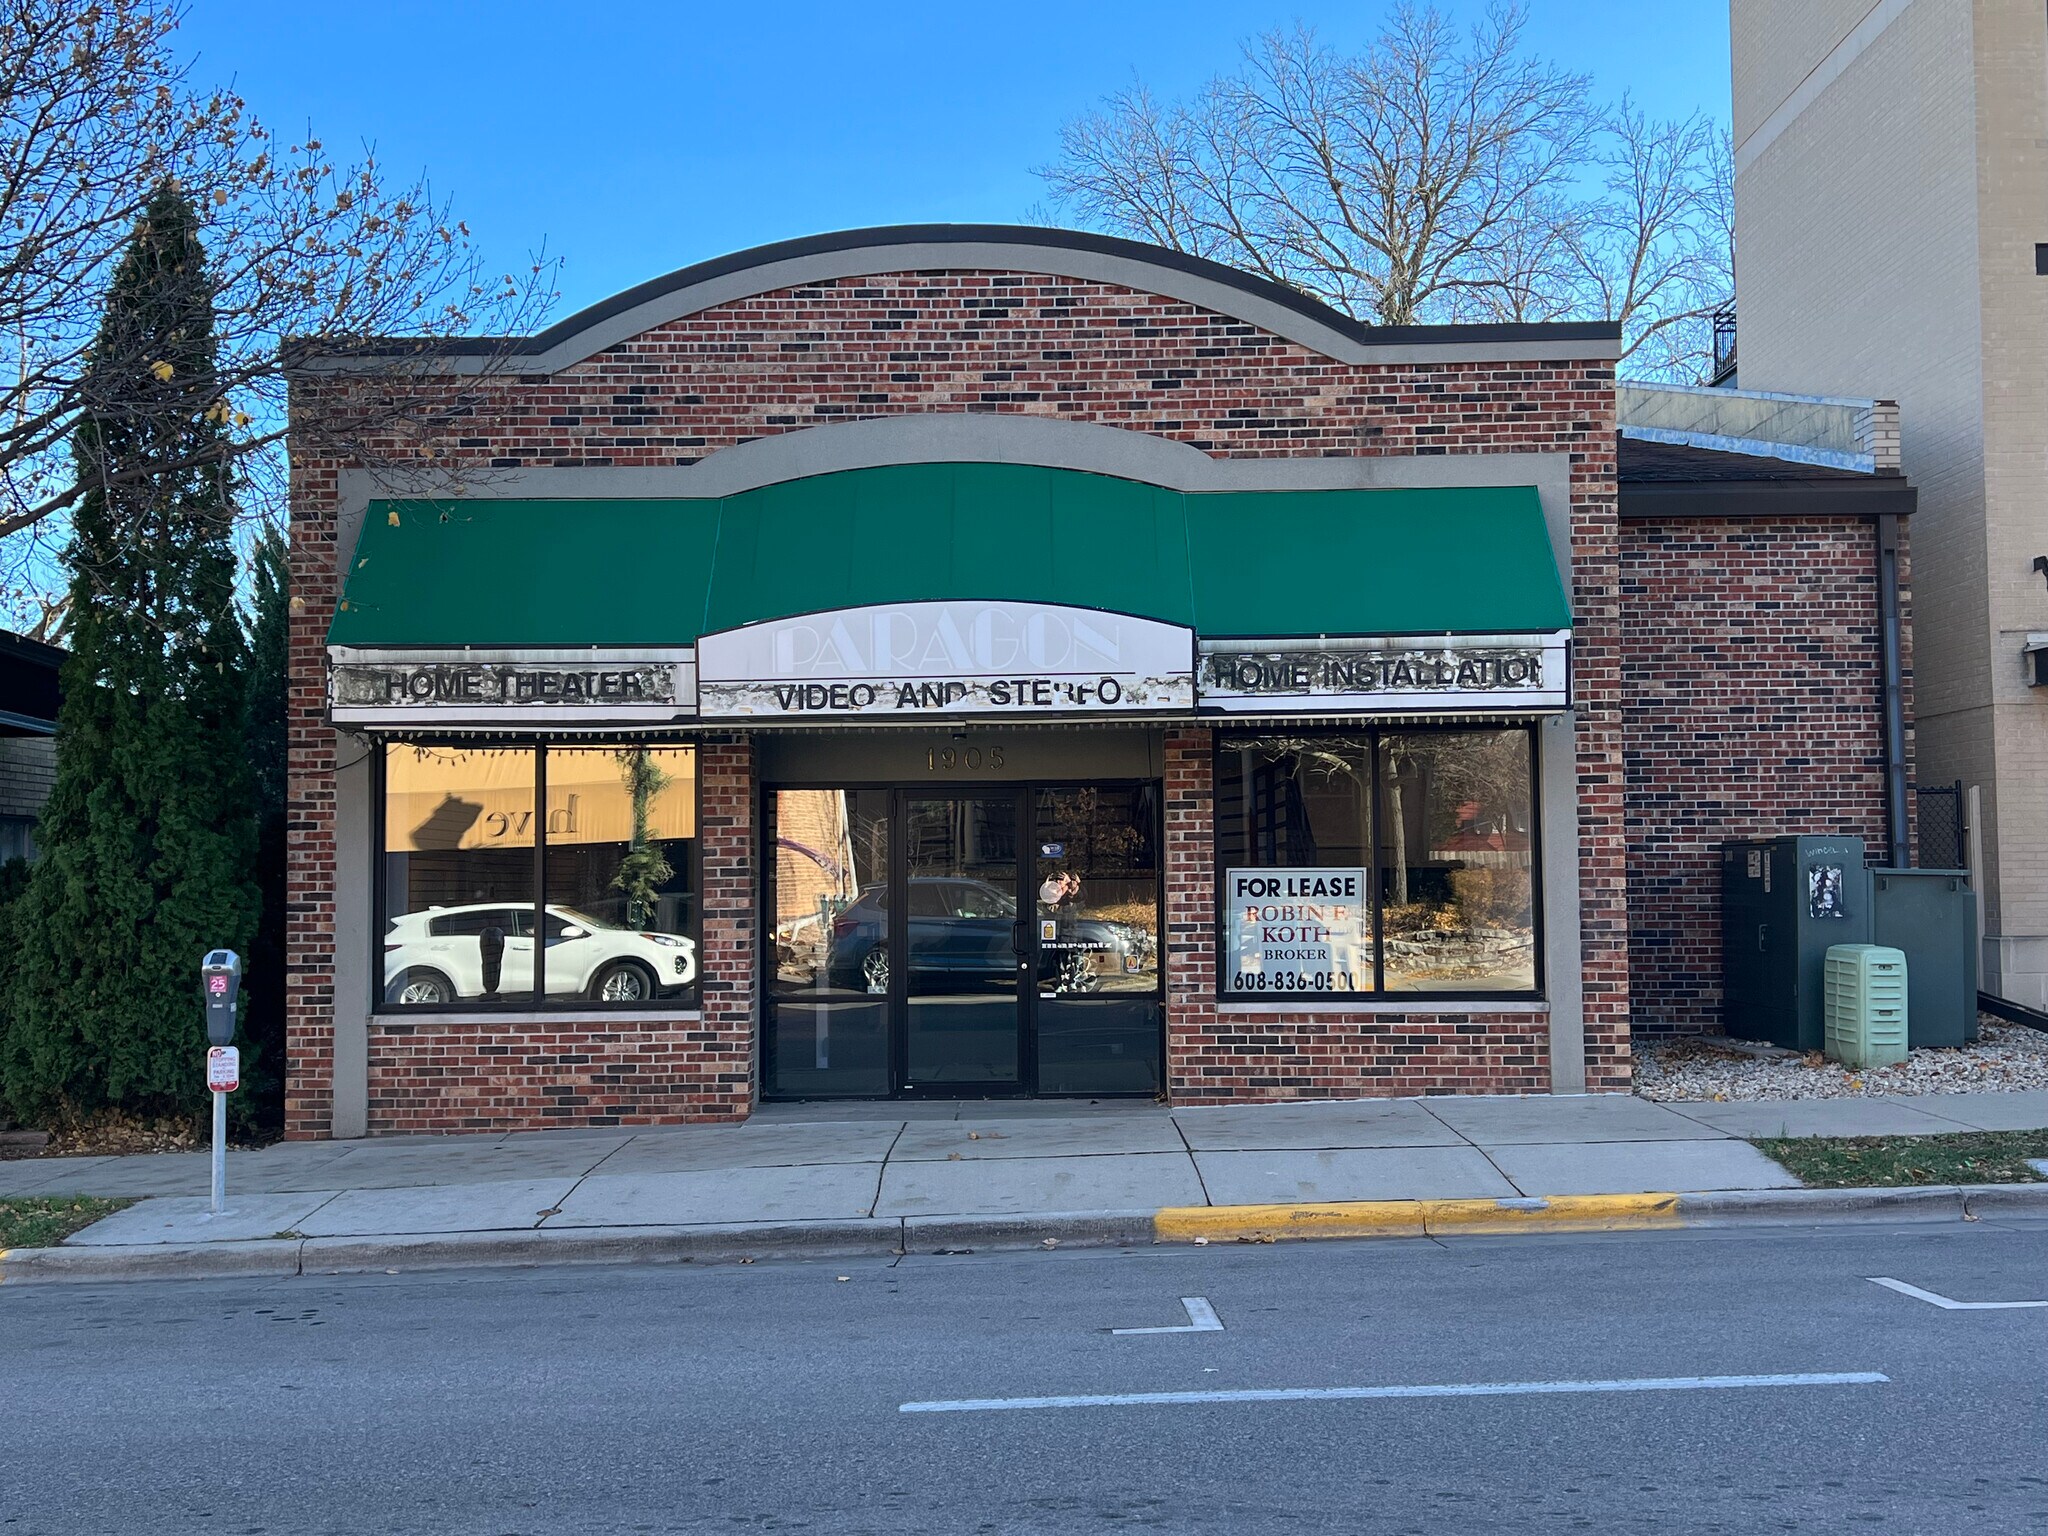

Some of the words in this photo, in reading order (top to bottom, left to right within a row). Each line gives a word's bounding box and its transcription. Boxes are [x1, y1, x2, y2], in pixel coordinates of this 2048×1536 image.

[772, 606, 1120, 674] PARAGON
[386, 671, 482, 699] HOME
[499, 671, 644, 699] THEATER
[1214, 660, 1310, 689] HOME
[774, 683, 876, 710] VIDEO
[896, 682, 968, 709] AND
[927, 746, 1004, 771] 1905
[1237, 878, 1281, 898] FOR
[1287, 877, 1356, 897] LEASE
[1245, 905, 1325, 922] ROBIN
[1262, 926, 1332, 943] KOTH
[1264, 949, 1328, 961] BROKER
[210, 979, 226, 990] 25
[1233, 971, 1359, 991] 608-836-0500
